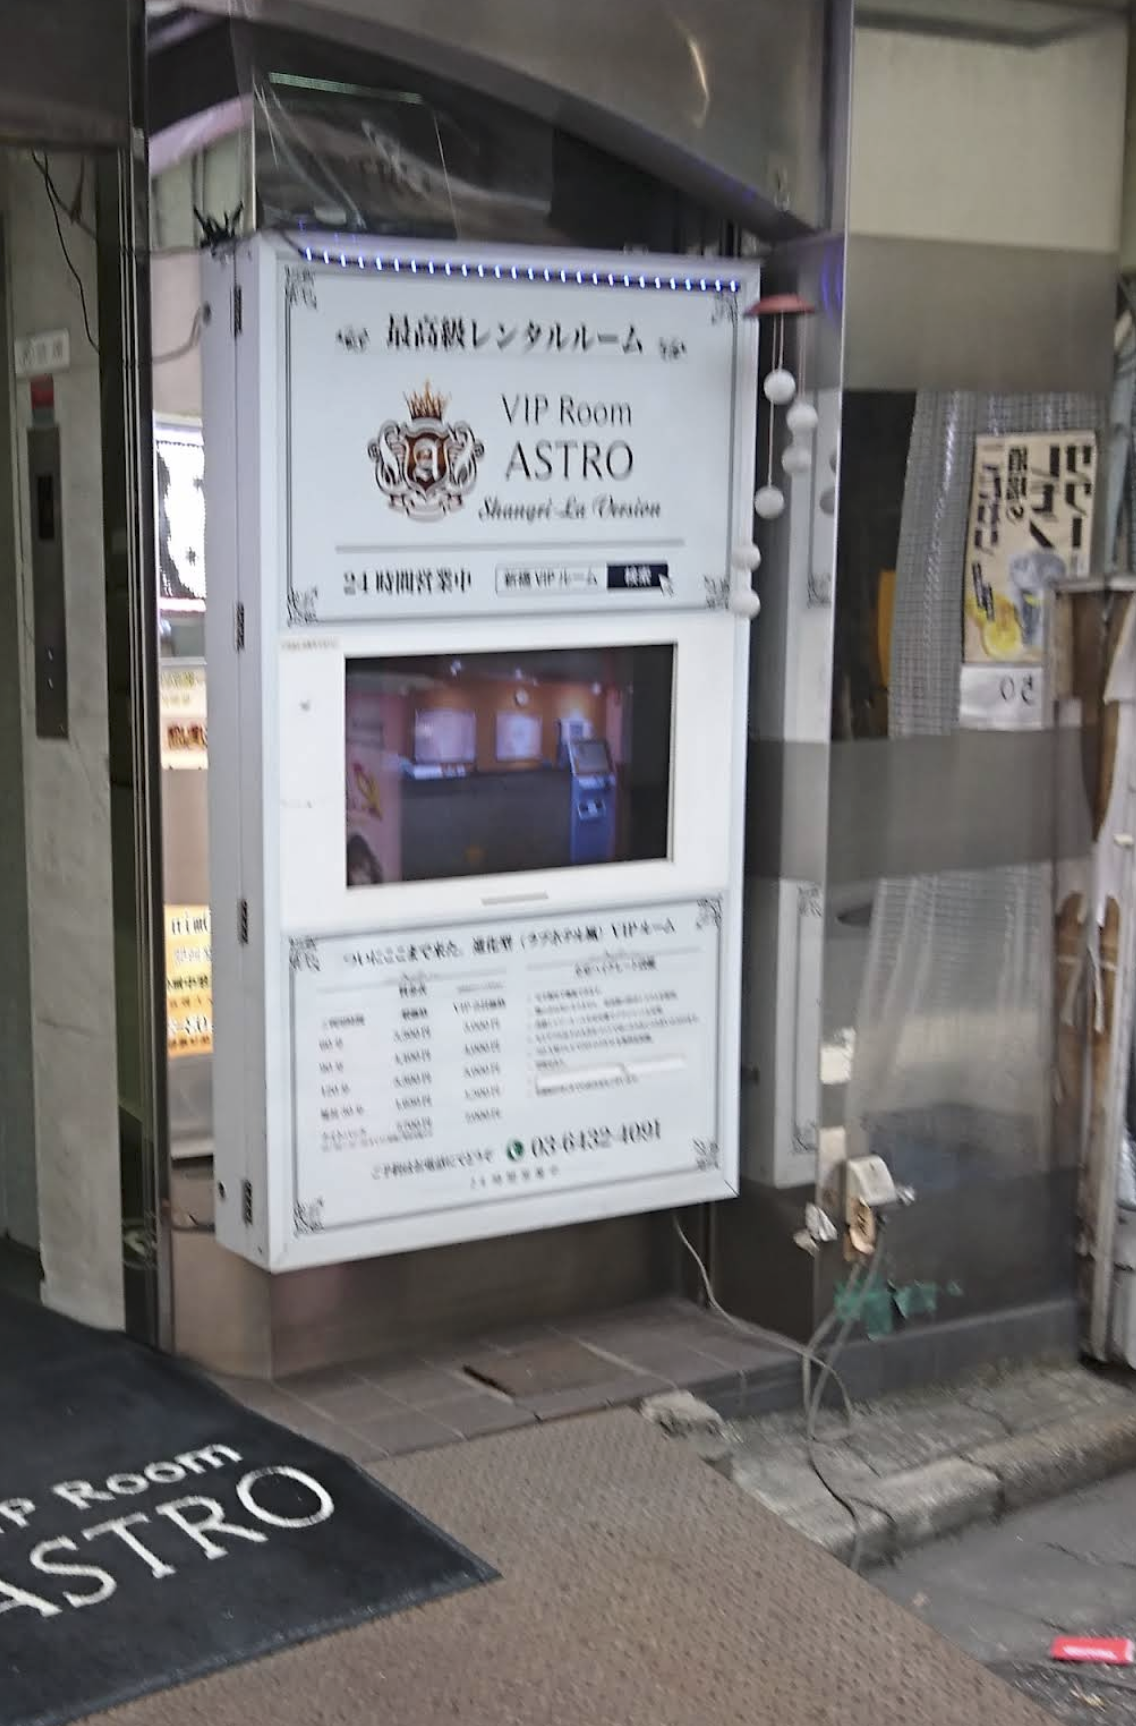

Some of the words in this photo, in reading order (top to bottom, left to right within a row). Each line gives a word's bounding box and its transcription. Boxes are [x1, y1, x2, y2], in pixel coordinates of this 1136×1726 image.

[387, 314, 643, 354] 最高級レンタルルーム
[502, 394, 548, 424] VIP
[560, 396, 632, 426] Room
[505, 440, 634, 482] ASTRO
[52, 1443, 244, 1510] Room
